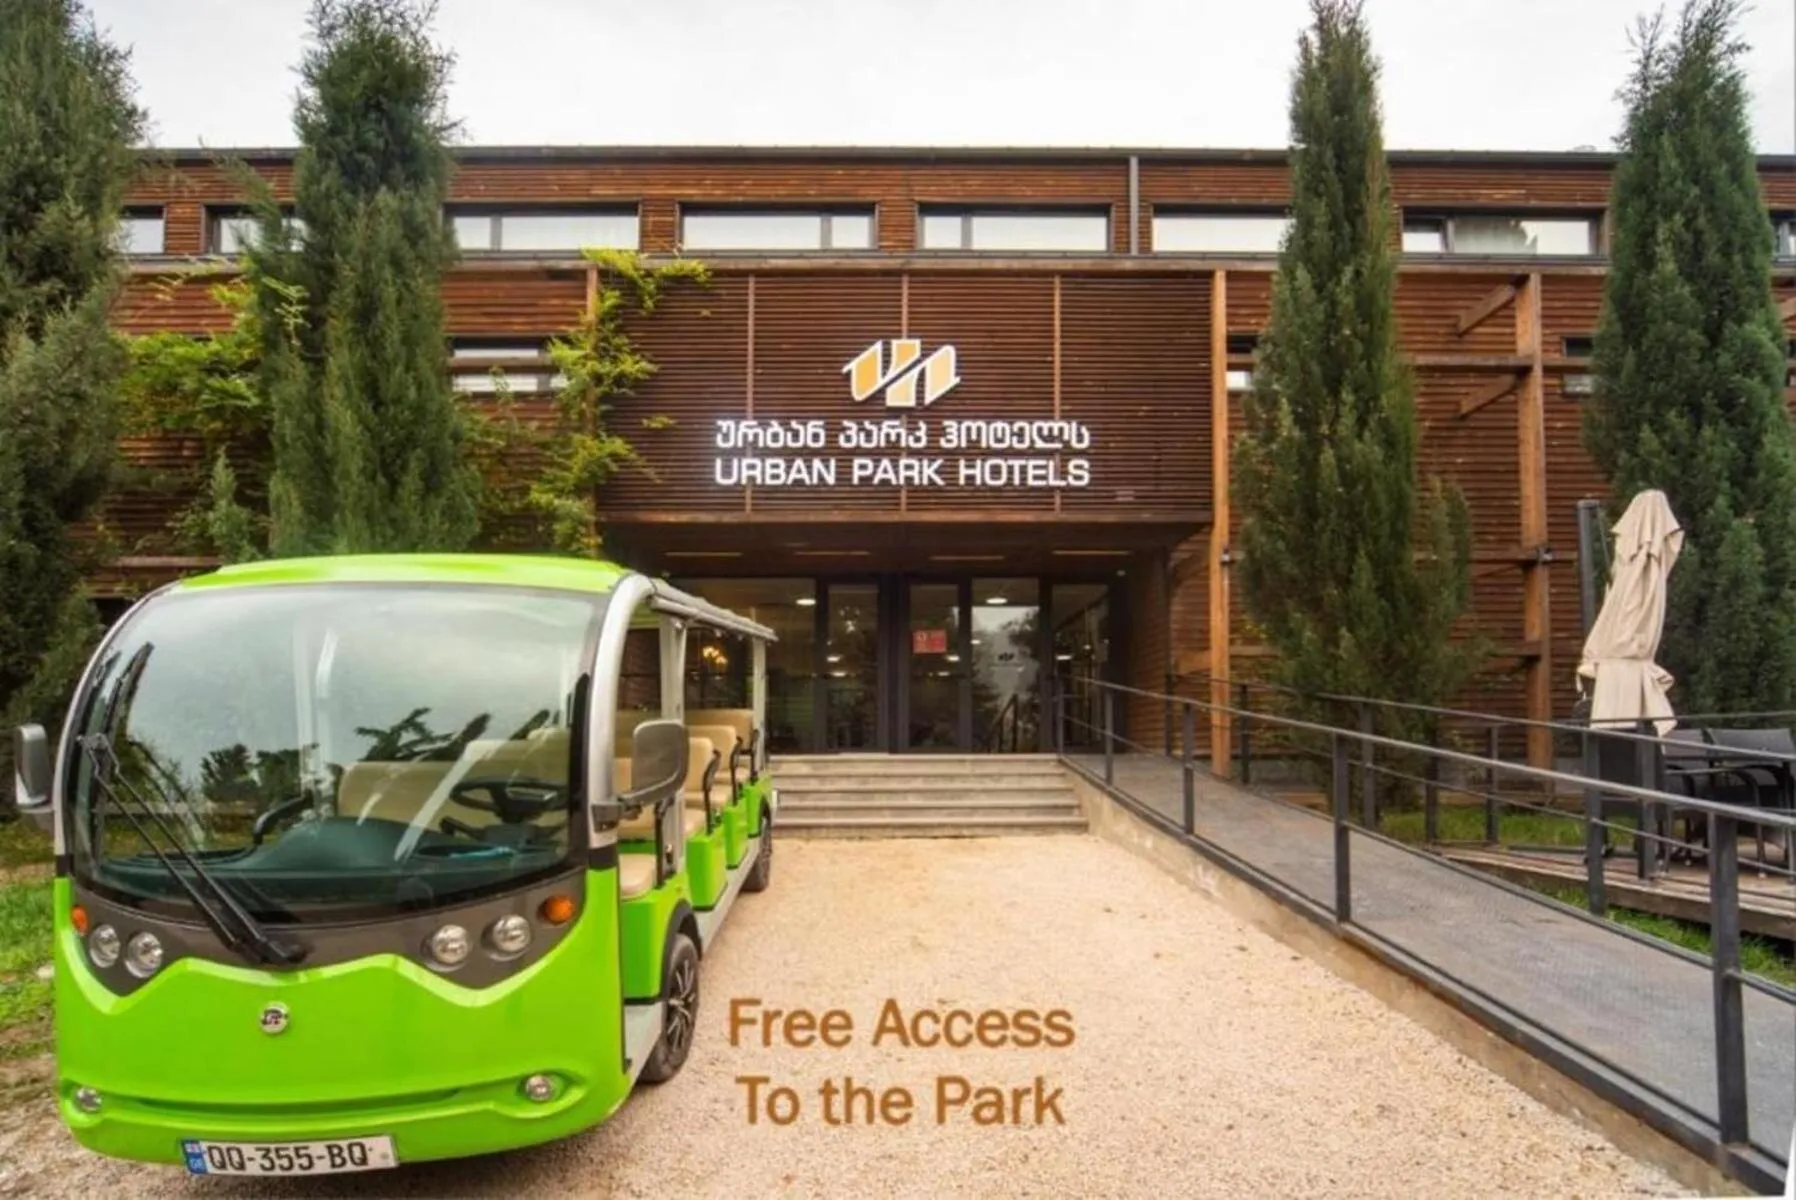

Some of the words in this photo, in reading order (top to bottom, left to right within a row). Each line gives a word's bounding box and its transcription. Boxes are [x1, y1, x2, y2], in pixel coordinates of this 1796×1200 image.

[716, 420, 826, 448] ურბან
[838, 420, 928, 448] პარკ
[715, 458, 836, 485] URBAN
[852, 458, 946, 485] PARK
[959, 458, 1090, 485] HOTELS
[206, 1141, 370, 1172] QQ-355-BQ
